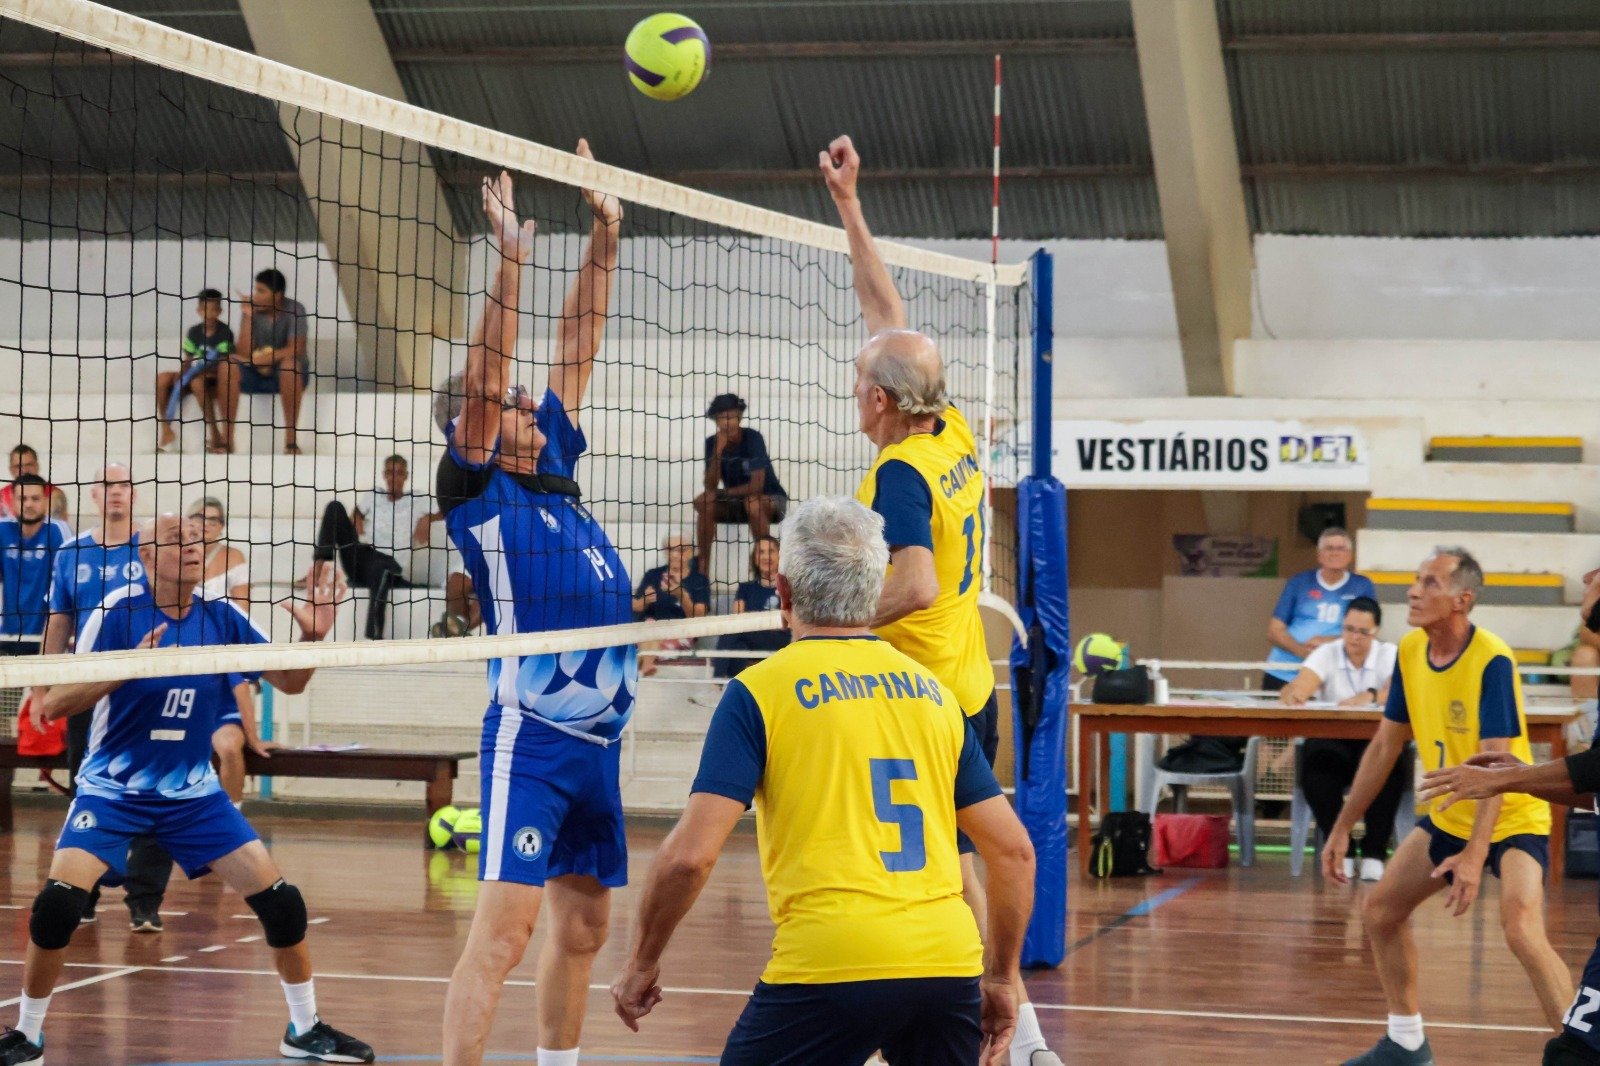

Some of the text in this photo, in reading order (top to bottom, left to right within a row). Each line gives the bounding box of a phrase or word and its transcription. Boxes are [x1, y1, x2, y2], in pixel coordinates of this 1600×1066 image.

[1077, 432, 1268, 472] VESTIÁRIOS
[1317, 603, 1341, 624] 10
[161, 688, 197, 719] 09
[795, 671, 943, 710] CAMPINAS
[869, 758, 927, 873] 5
